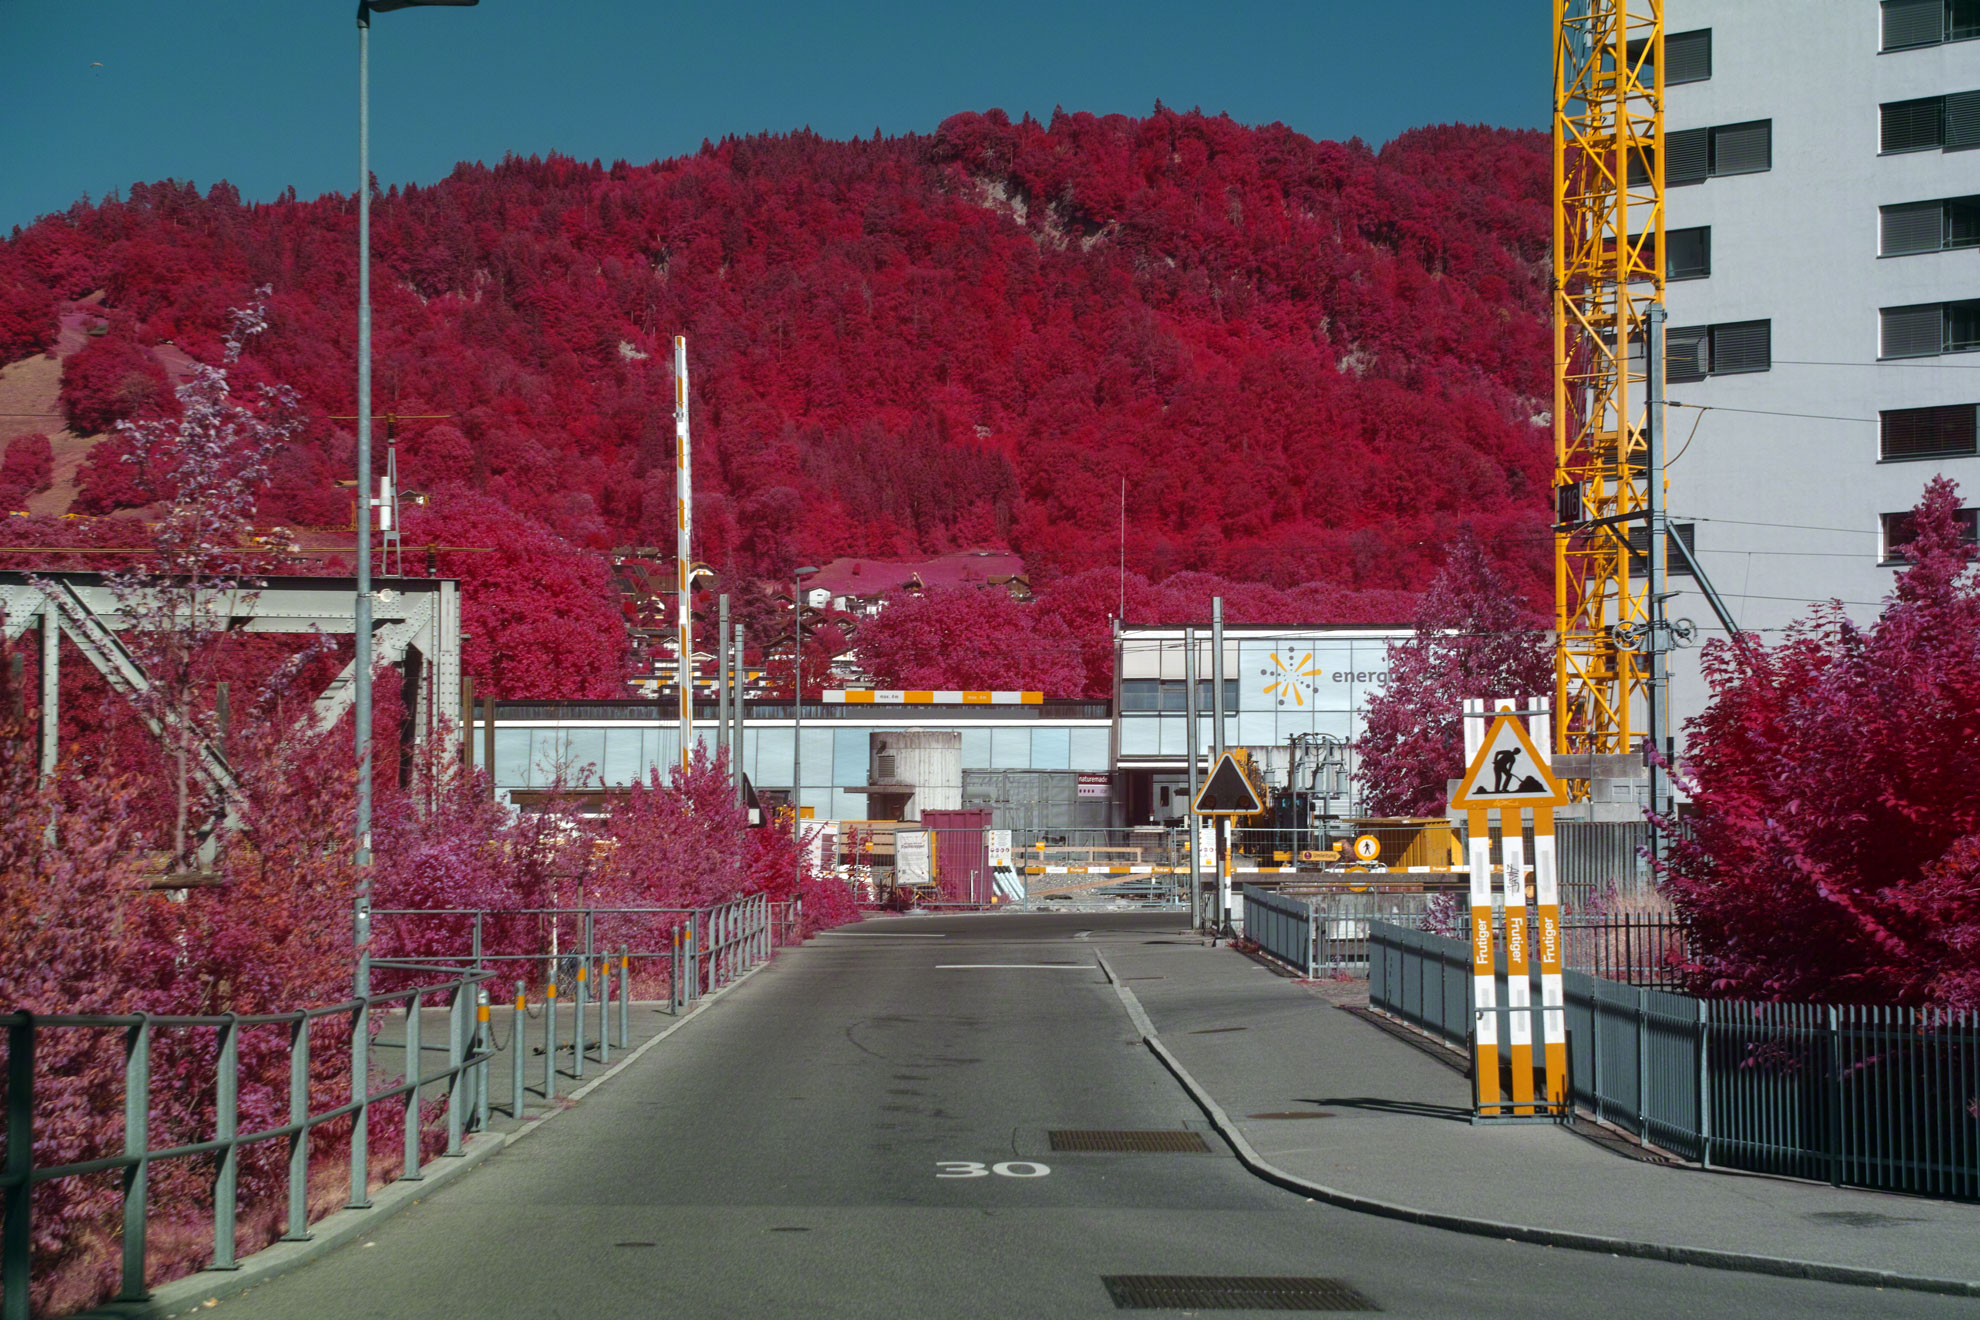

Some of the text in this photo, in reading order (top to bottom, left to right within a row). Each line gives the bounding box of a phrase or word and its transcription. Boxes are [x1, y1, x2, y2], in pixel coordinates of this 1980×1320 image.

[1561, 490, 1578, 517] 116
[1476, 918, 1490, 964] Frutiger
[1509, 917, 1524, 963] Frutiger
[1542, 917, 1556, 963] Frutiger
[935, 1161, 1051, 1178] 30
